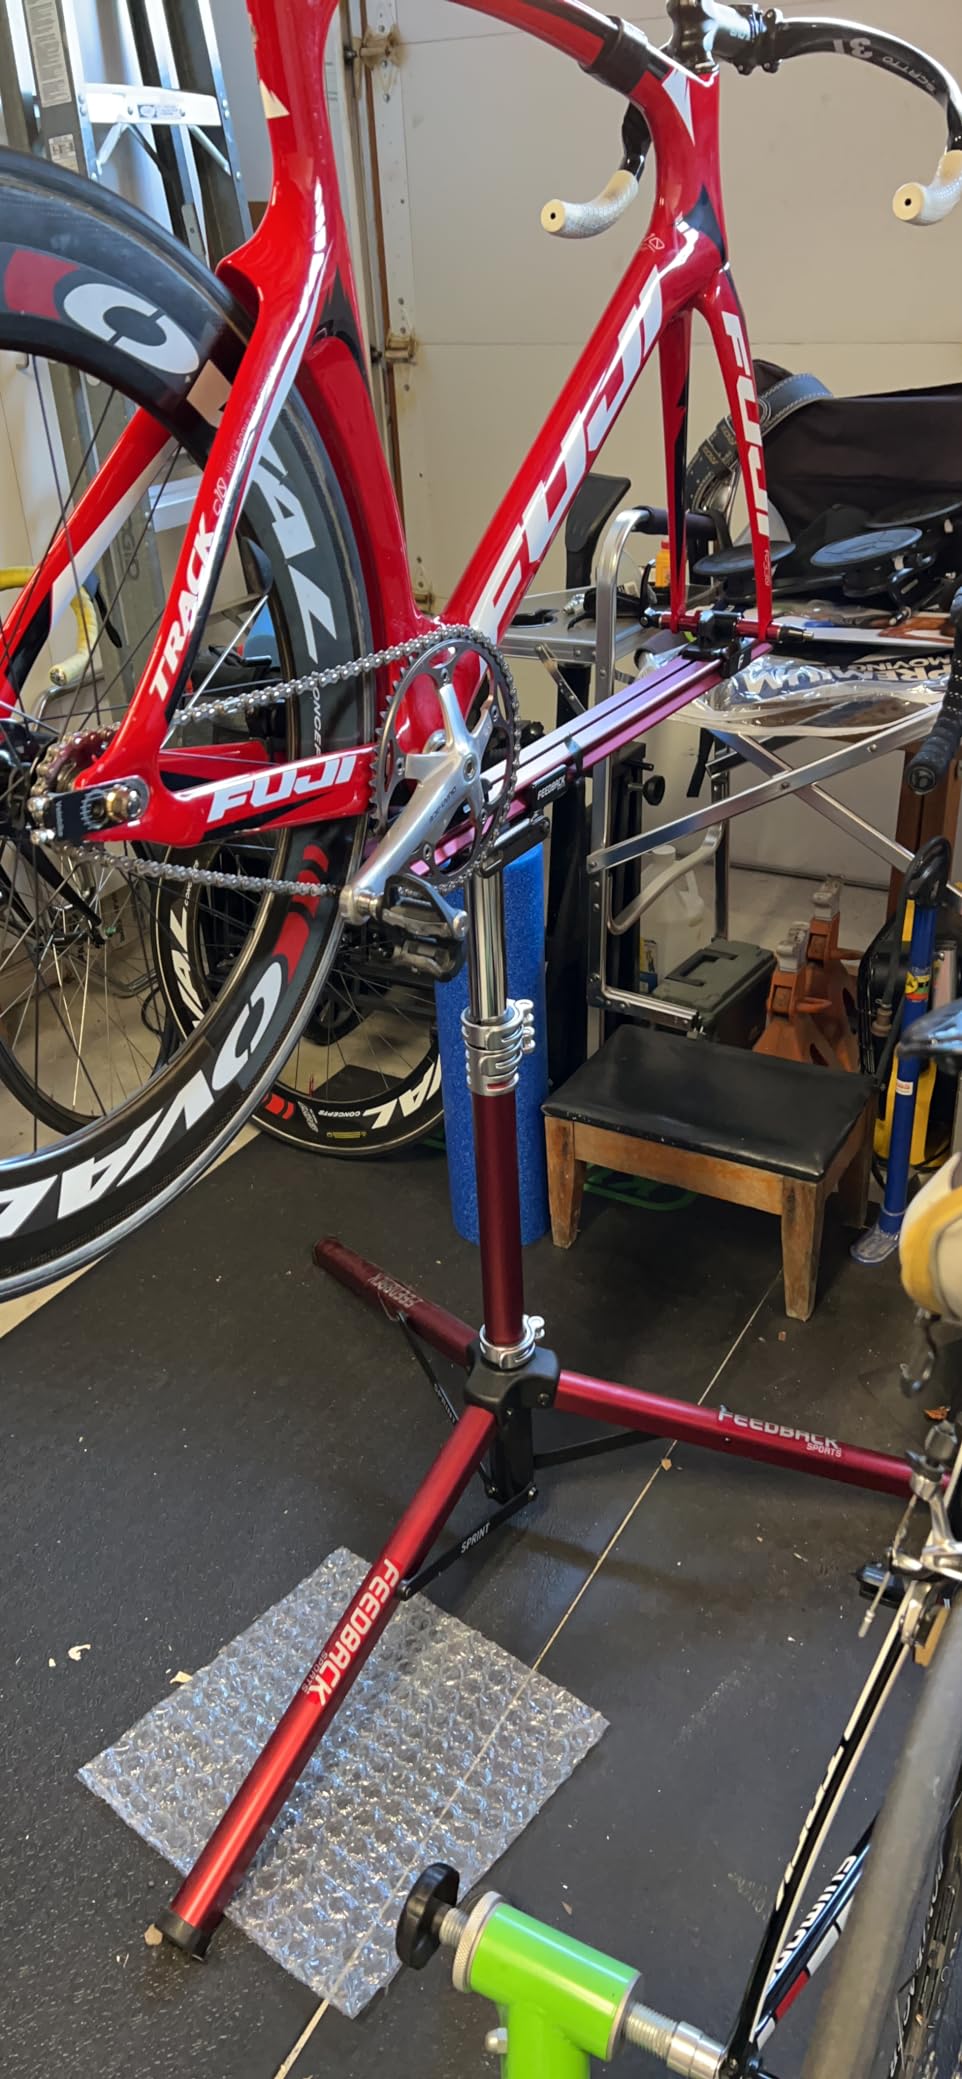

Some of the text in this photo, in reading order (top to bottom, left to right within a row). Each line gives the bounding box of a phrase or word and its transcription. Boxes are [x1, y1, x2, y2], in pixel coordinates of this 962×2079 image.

[468, 264, 663, 640] FUJI
[721, 310, 769, 537] FUJI
[149, 512, 215, 702] TRACK
[206, 755, 357, 822] FUJI
[717, 1406, 841, 1450] FEEDBACK
[806, 1442, 843, 1459] SPORTS
[460, 1521, 492, 1555] SPRINT
[304, 1558, 400, 1708] FEEDBACK
[301, 1650, 329, 1695] SPORTS
